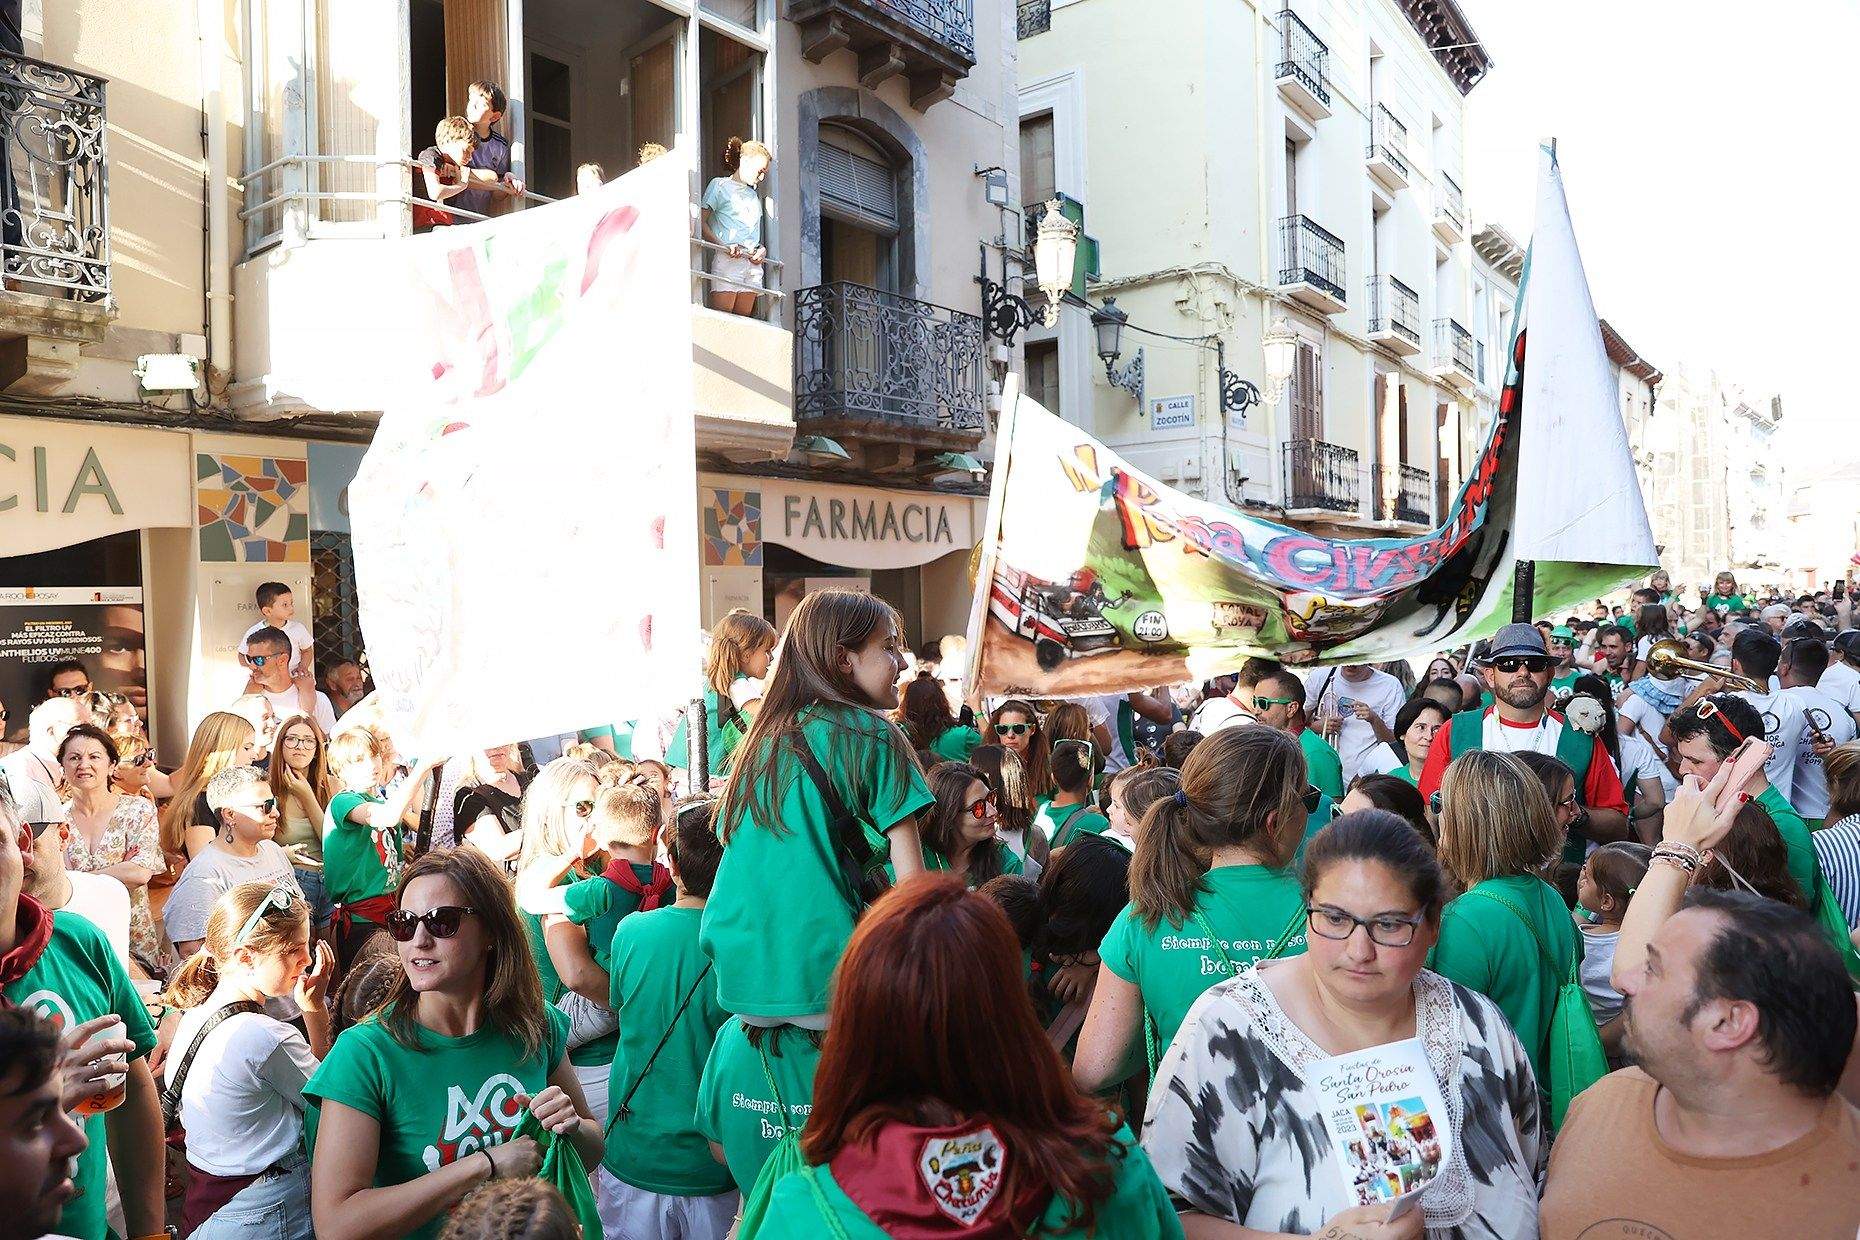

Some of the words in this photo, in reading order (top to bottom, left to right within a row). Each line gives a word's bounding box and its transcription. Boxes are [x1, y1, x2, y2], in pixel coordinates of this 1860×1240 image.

[1168, 401, 1189, 409] CALLE
[784, 495, 953, 544] FARMACIA
[1142, 614, 1161, 625] FIN
[33, 637, 43, 645] UV
[22, 655, 58, 663] FLUIDOS
[1233, 940, 1262, 951] con
[1320, 1073, 1363, 1092] Santa
[1336, 1088, 1365, 1104] San
[1366, 1081, 1410, 1097] Pedro
[1331, 1108, 1351, 1119] JACA
